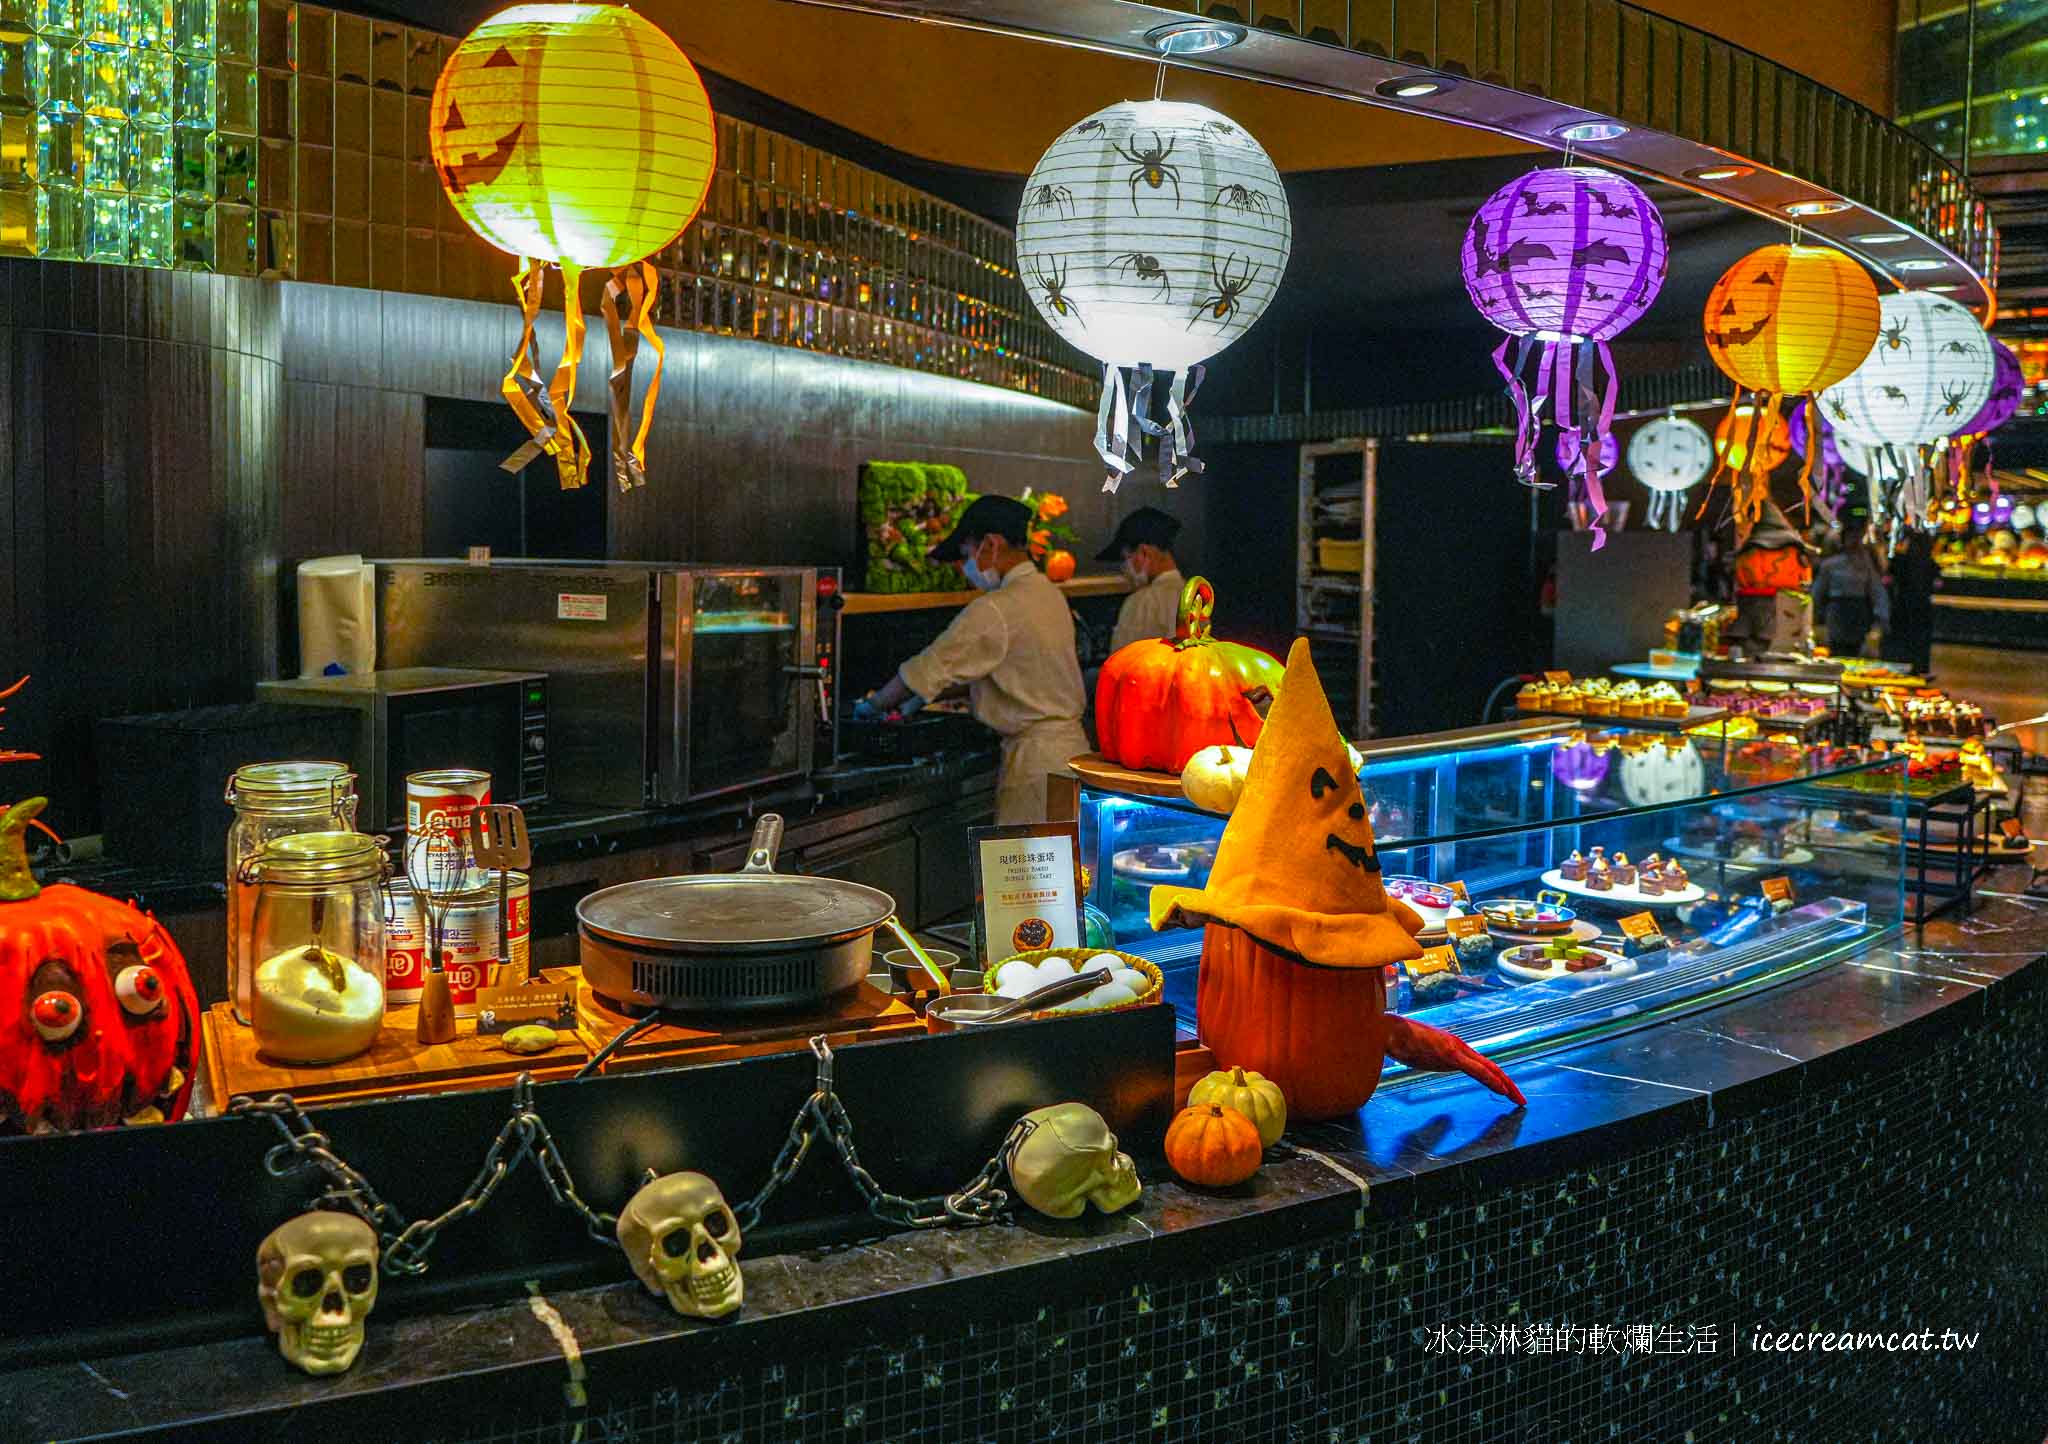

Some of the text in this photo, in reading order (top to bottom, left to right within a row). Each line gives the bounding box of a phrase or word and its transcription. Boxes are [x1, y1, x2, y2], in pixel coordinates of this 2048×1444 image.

[1000, 852, 1055, 865] 現烤珍珠蛋塔
